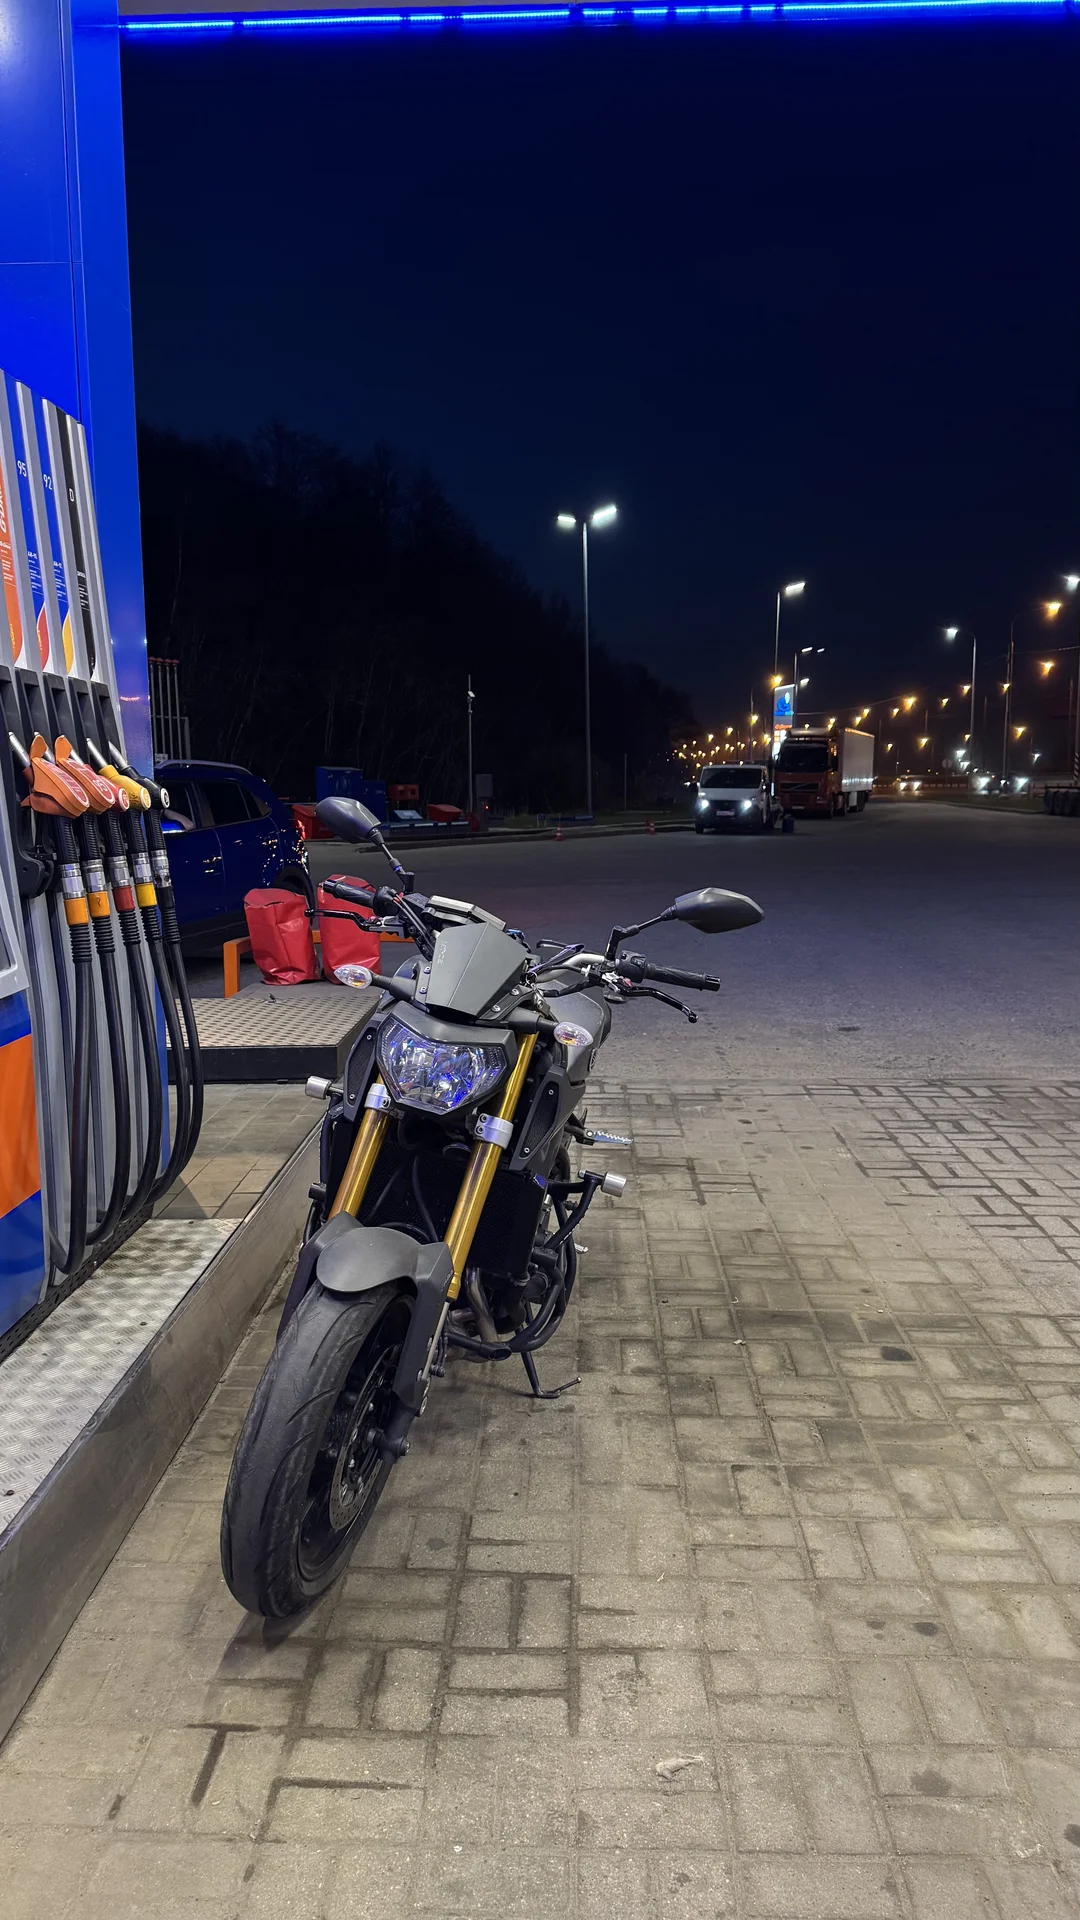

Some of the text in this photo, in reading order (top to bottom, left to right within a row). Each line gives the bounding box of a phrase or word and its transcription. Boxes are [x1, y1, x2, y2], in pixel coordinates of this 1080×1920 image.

[17, 460, 27, 477] 95
[43, 474, 53, 490] 92
[69, 488, 75, 502] D
